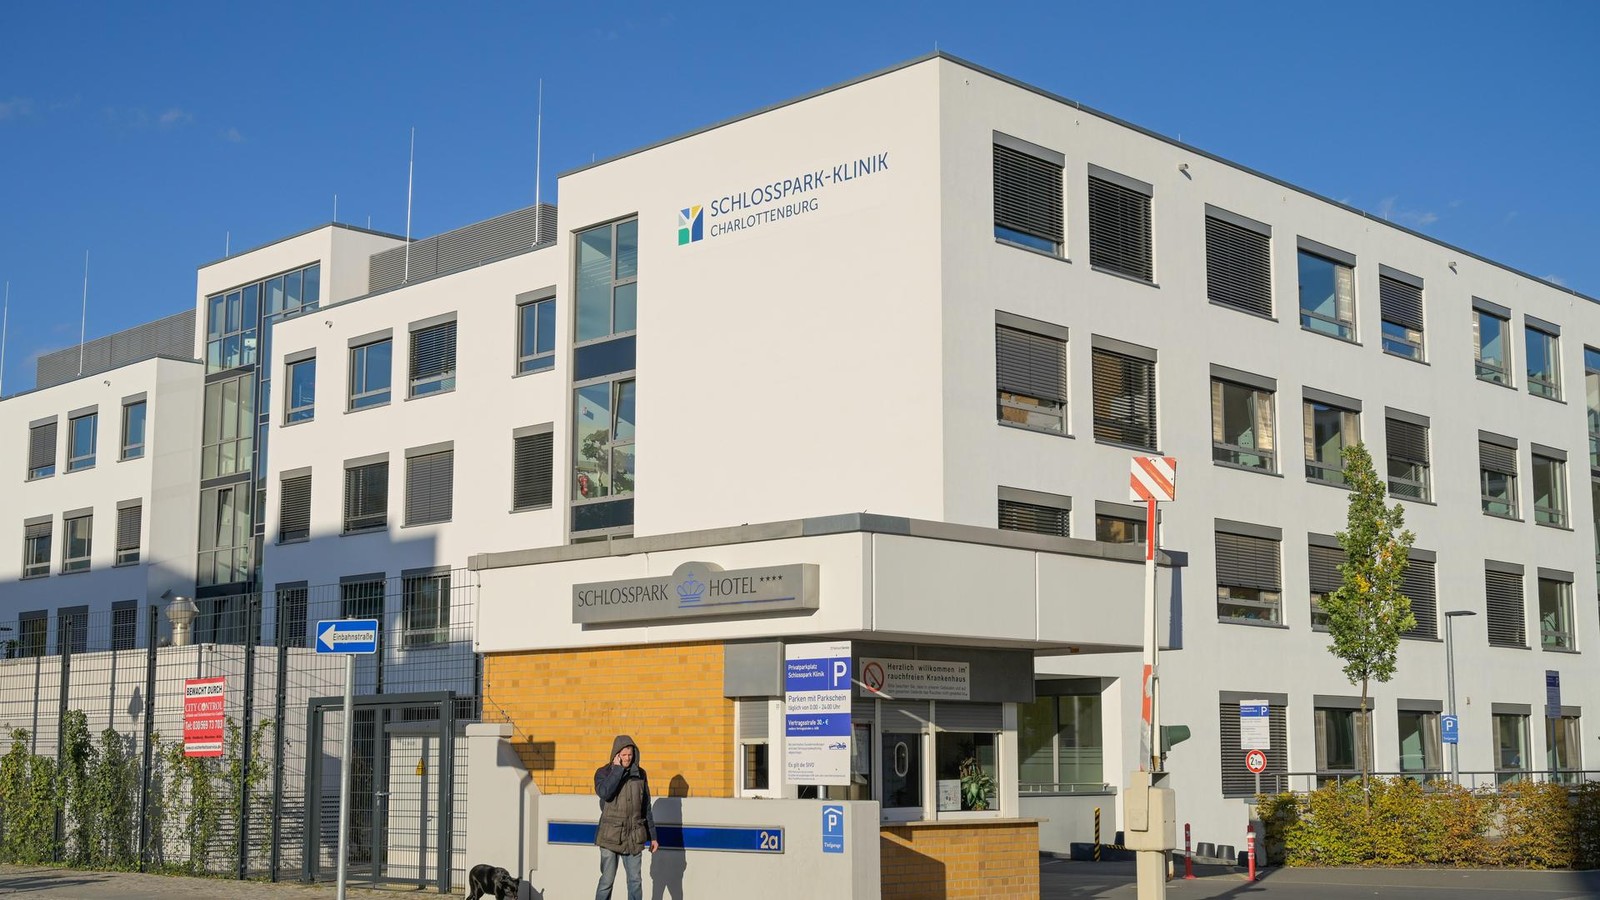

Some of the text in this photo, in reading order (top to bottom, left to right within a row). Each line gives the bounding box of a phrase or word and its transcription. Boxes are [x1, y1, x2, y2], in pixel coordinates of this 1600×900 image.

[710, 151, 889, 217] SCHLOSSPARK-KLINIK
[710, 197, 819, 237] CHARLOTTENBURG
[578, 576, 757, 608] SCHLOSSPARK HOTEL
[333, 632, 373, 641] Einbahnstraße
[887, 662, 914, 671] Herzlich
[918, 664, 955, 673] willkommen
[834, 661, 847, 687] P
[887, 672, 966, 683] rauchfreien Krankenhaus
[186, 685, 222, 696] BEWACHT DURCH
[817, 694, 847, 702] Parkschein
[185, 702, 198, 712] CITY
[1261, 706, 1267, 716] P
[1446, 720, 1453, 731] P
[828, 814, 837, 832] P
[760, 831, 779, 850] 2a
